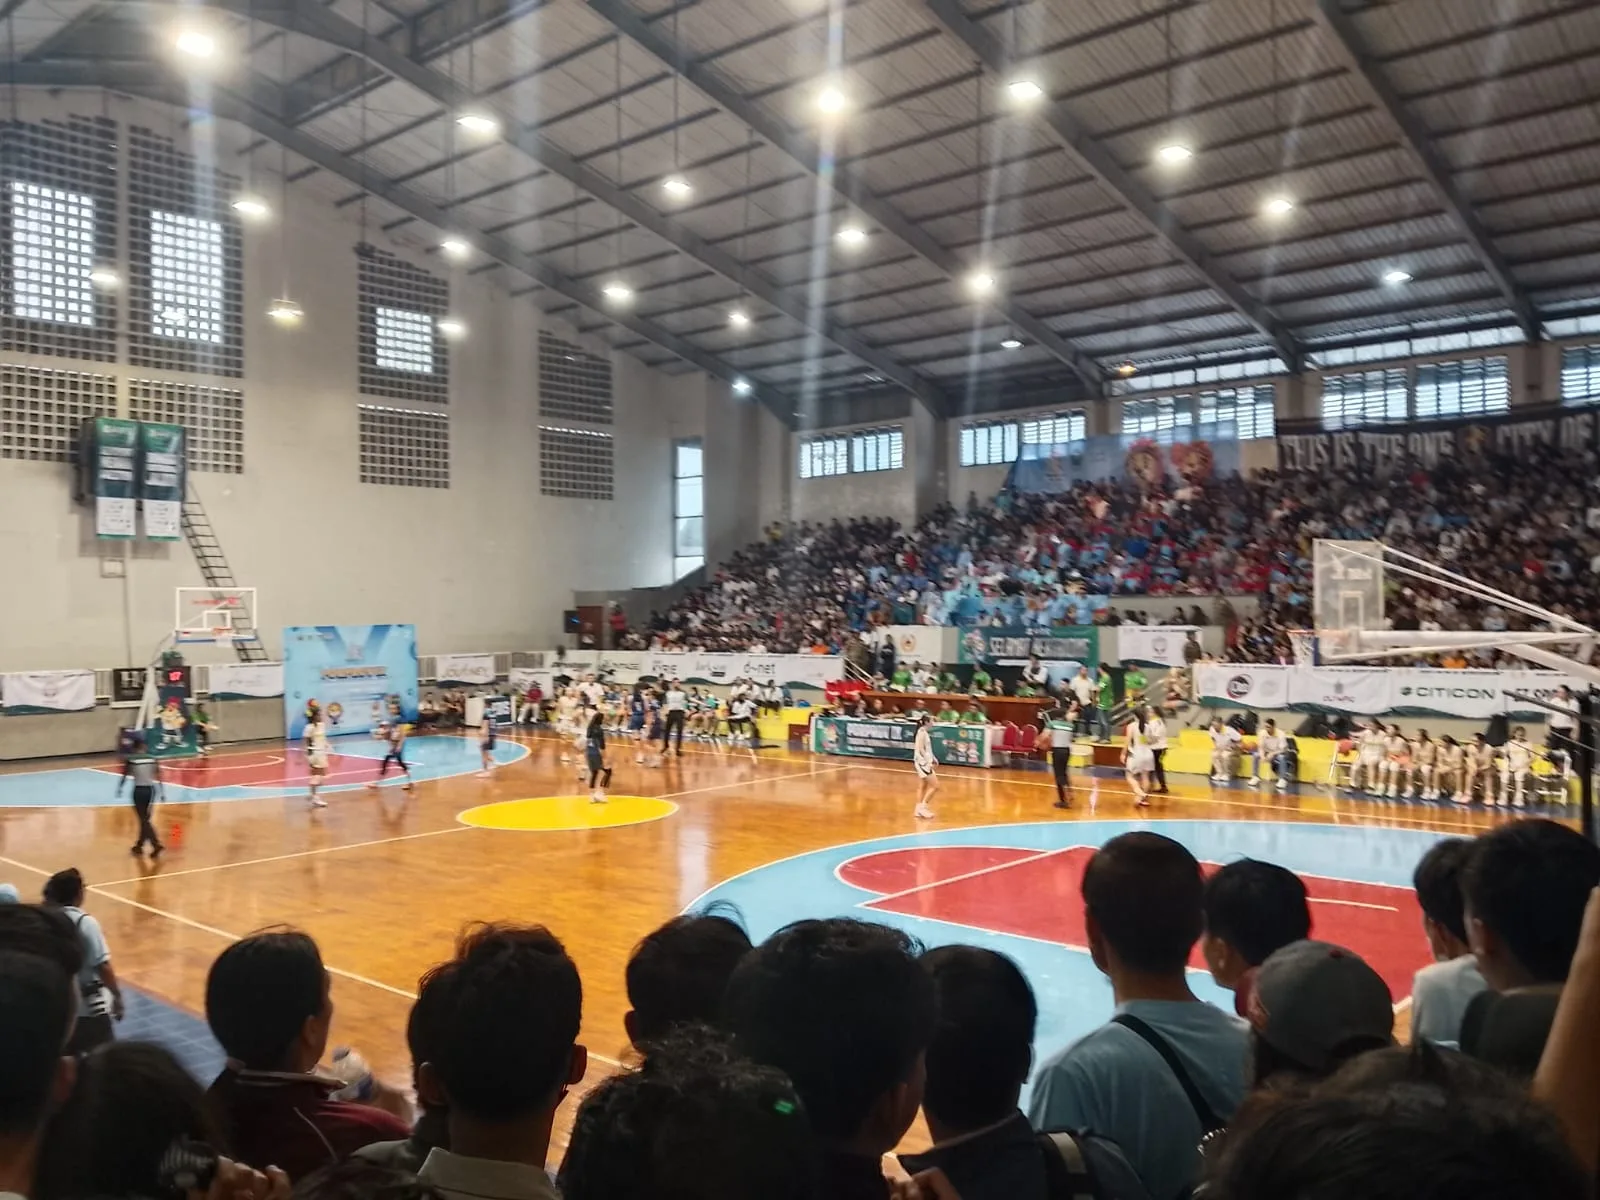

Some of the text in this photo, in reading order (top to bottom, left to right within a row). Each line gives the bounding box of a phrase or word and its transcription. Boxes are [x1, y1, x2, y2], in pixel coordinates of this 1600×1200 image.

[1280, 413, 1594, 471] THIS IS THE ONE CITY OF
[1416, 686, 1496, 700] CITICON
